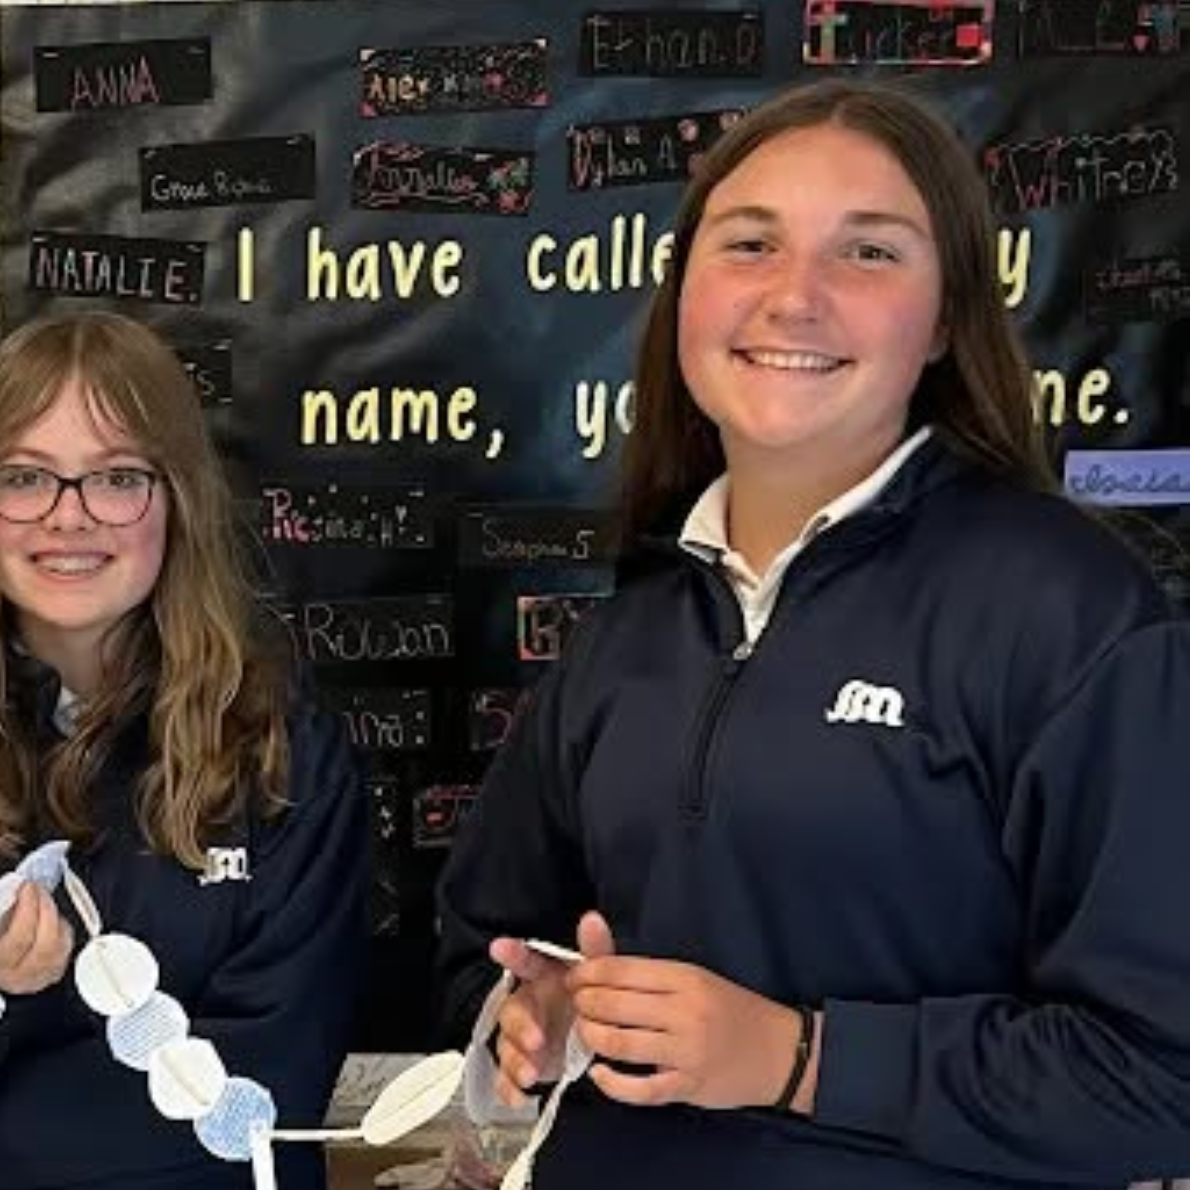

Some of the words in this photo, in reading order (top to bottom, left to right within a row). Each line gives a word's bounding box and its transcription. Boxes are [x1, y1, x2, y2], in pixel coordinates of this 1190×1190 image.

[71, 55, 160, 113] ANNA
[238, 226, 254, 301] I
[308, 226, 462, 301] have
[527, 213, 675, 292] calle
[998, 228, 1031, 308] y
[302, 386, 503, 458] name,
[1031, 368, 1130, 427] ne.
